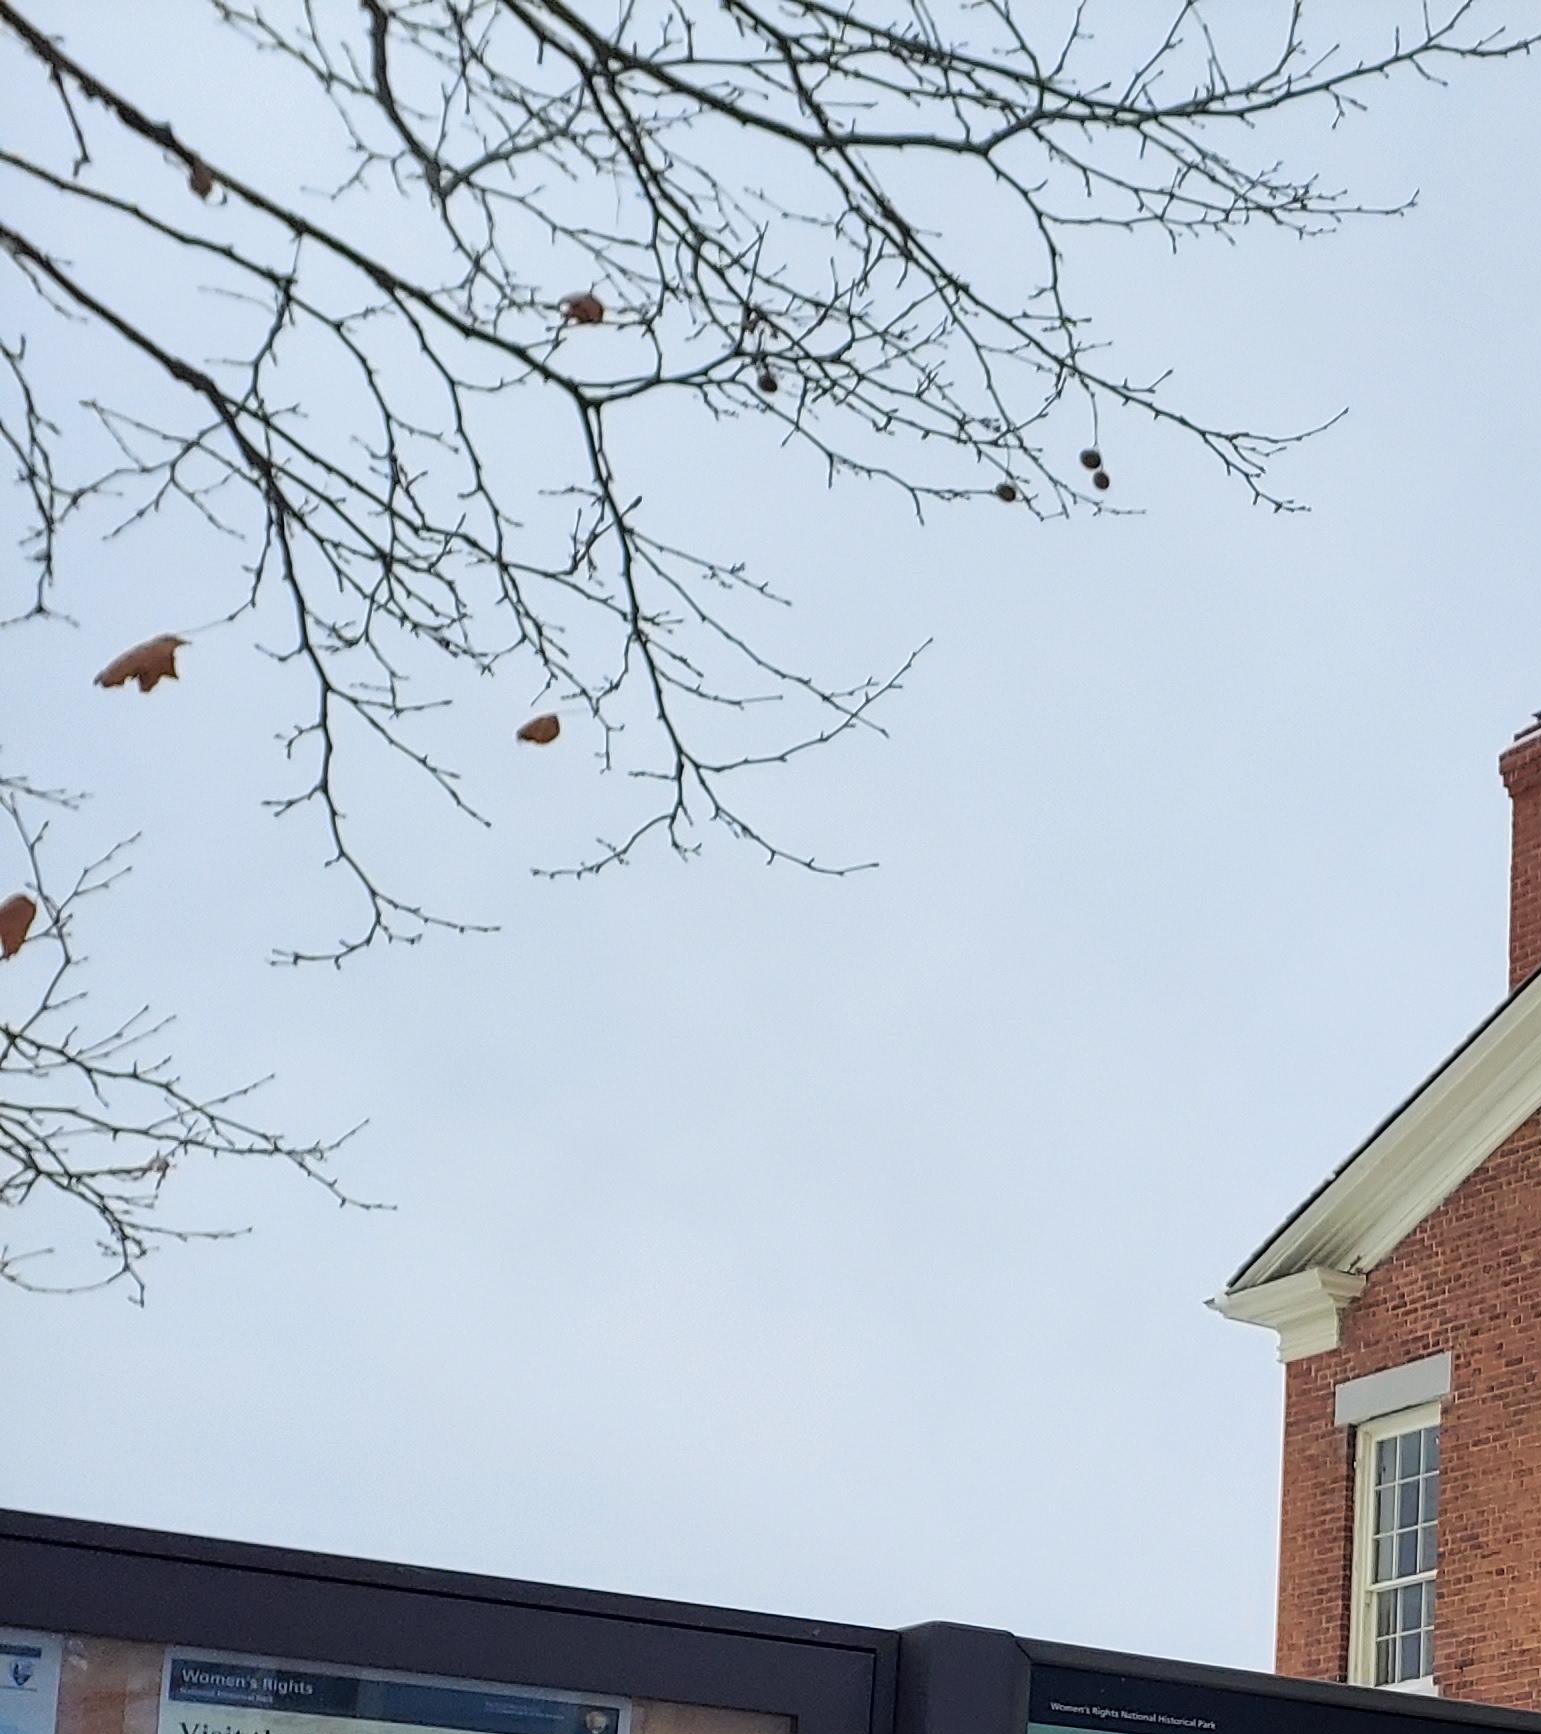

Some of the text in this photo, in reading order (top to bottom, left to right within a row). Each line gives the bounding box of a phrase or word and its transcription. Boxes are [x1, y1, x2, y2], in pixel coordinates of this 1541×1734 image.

[179, 1670, 312, 1694] Women's Rights
[1050, 1702, 1216, 1729] Women's Rights National Historical Park
